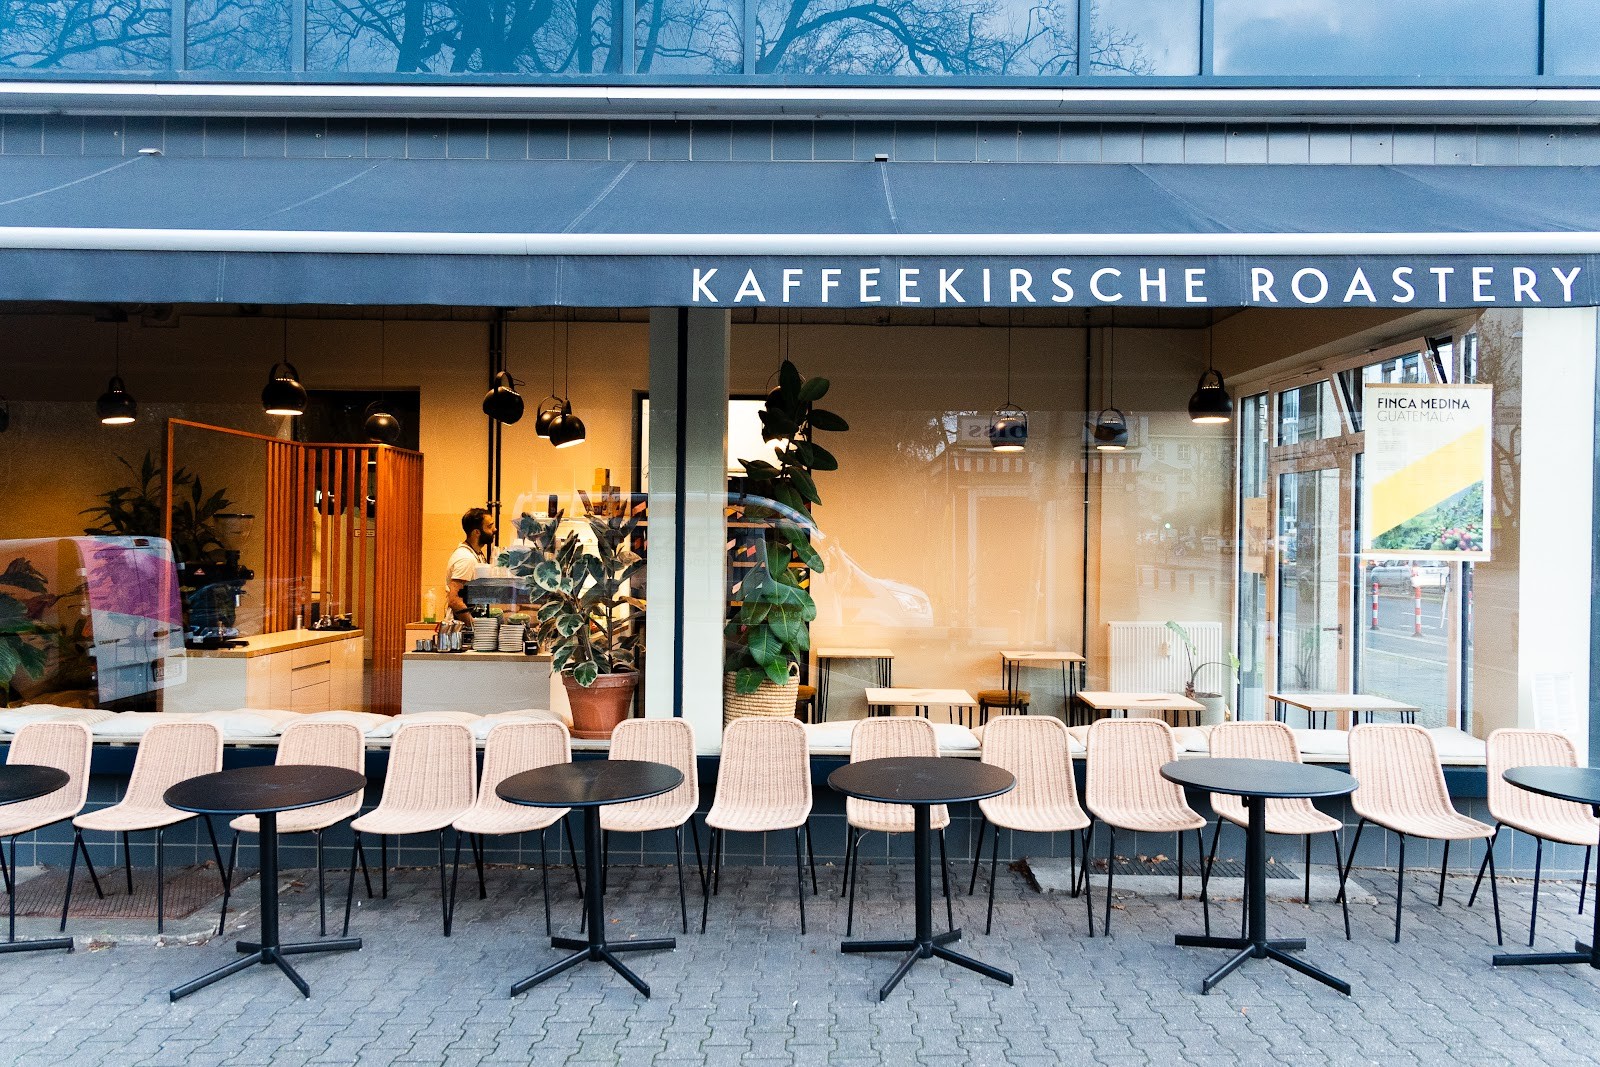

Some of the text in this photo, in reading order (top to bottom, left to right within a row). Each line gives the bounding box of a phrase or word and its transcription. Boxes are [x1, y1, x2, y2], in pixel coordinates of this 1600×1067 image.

[692, 266, 1582, 304] KAFFEEKIRSCHE ROASTERY
[1377, 397, 1471, 410] FINCA MEDINA
[1377, 410, 1455, 422] GUATEMALA
